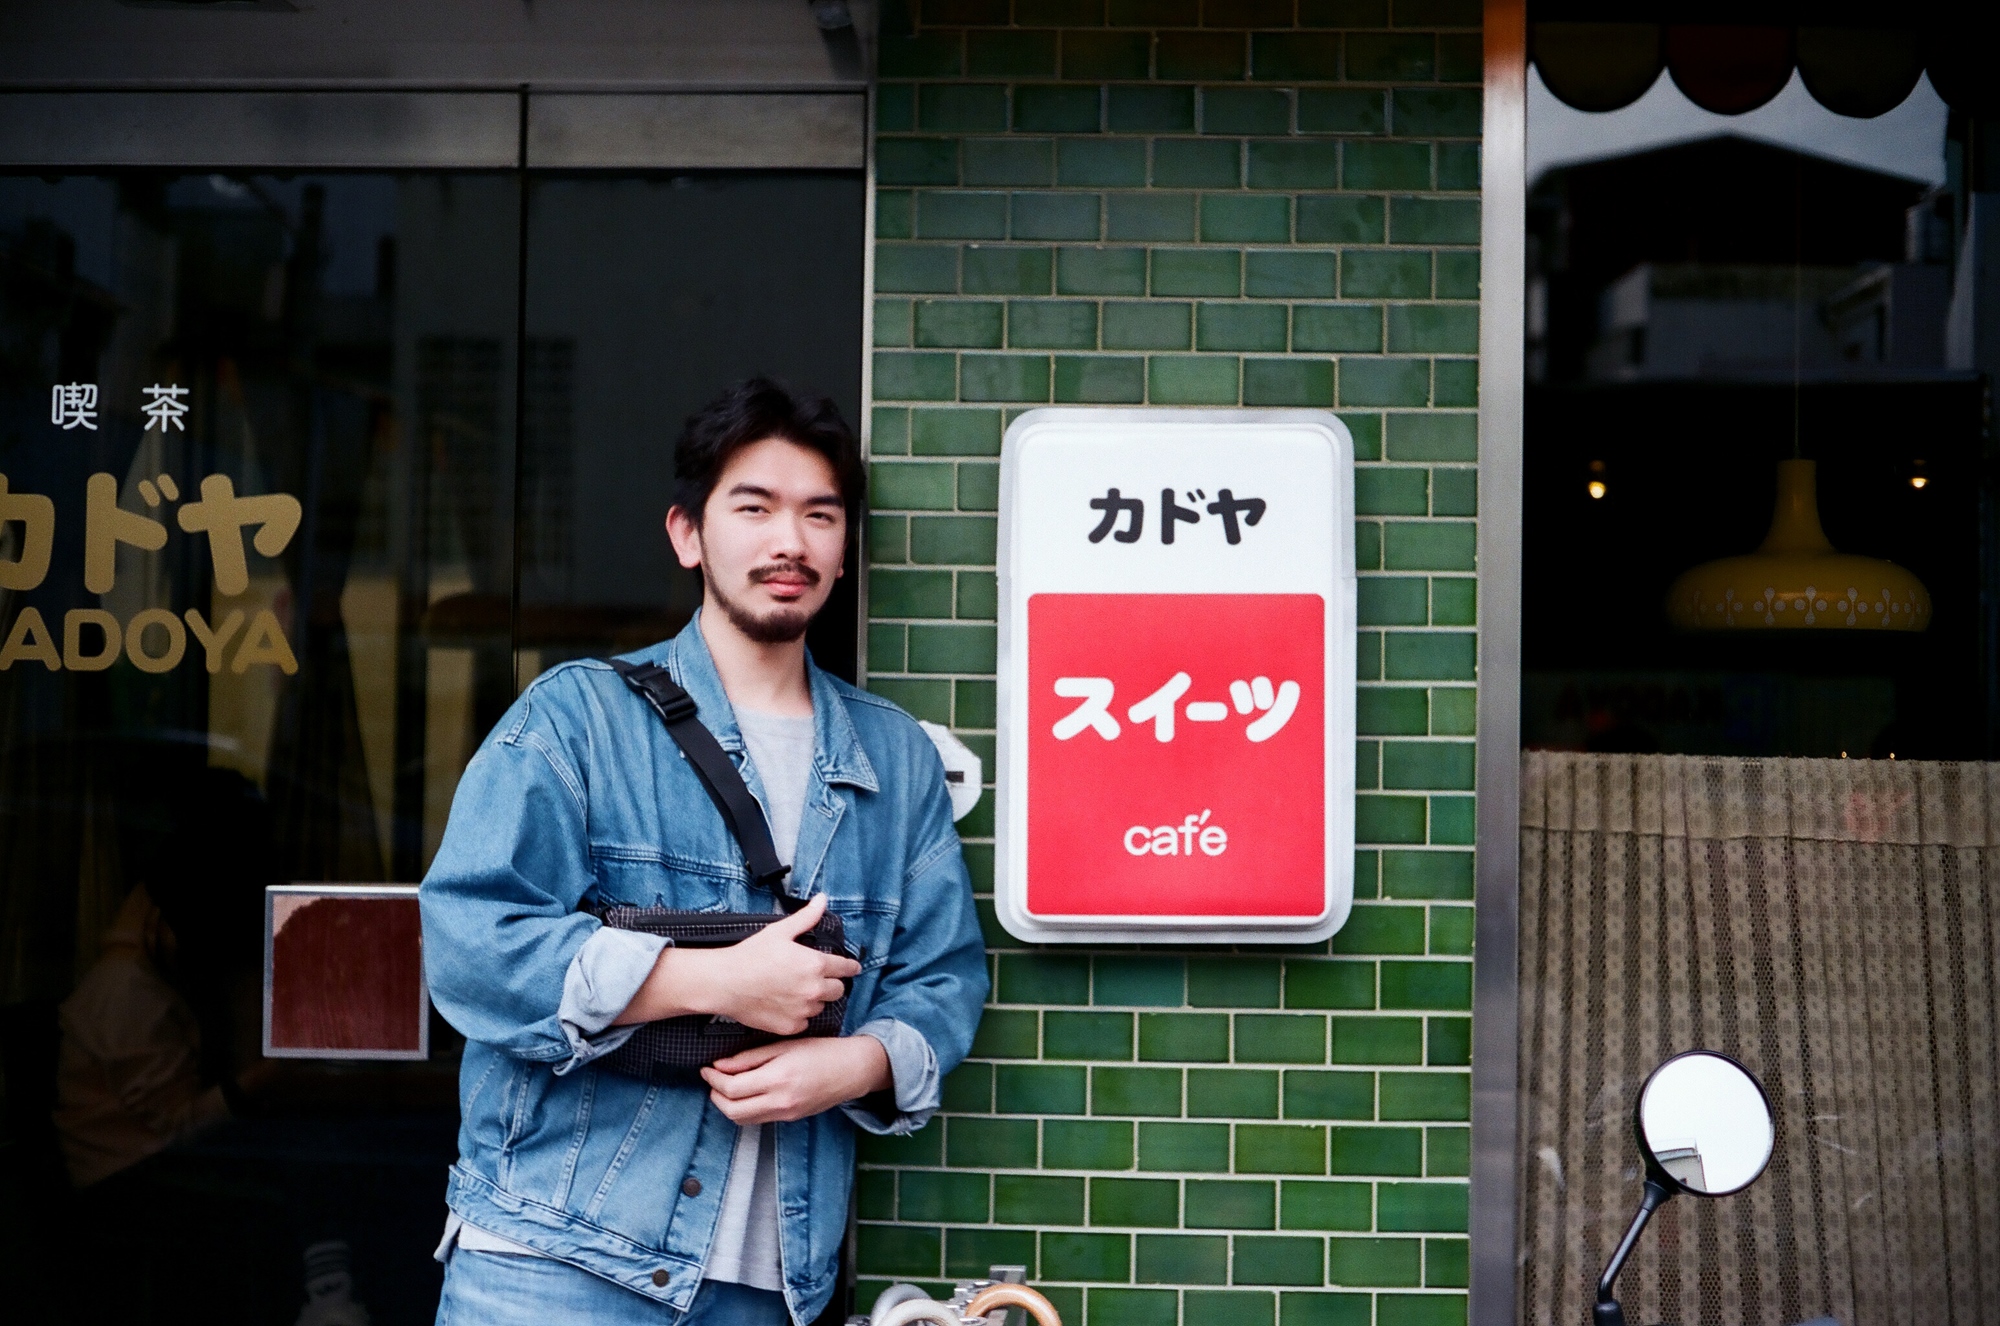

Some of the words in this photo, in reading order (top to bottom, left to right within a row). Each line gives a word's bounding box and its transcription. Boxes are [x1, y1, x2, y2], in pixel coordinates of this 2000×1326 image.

[52, 382, 189, 432] 喫茶
[1088, 488, 1267, 545] カドヤ
[1052, 671, 1301, 743] スイーツ
[1123, 808, 1228, 856] café
